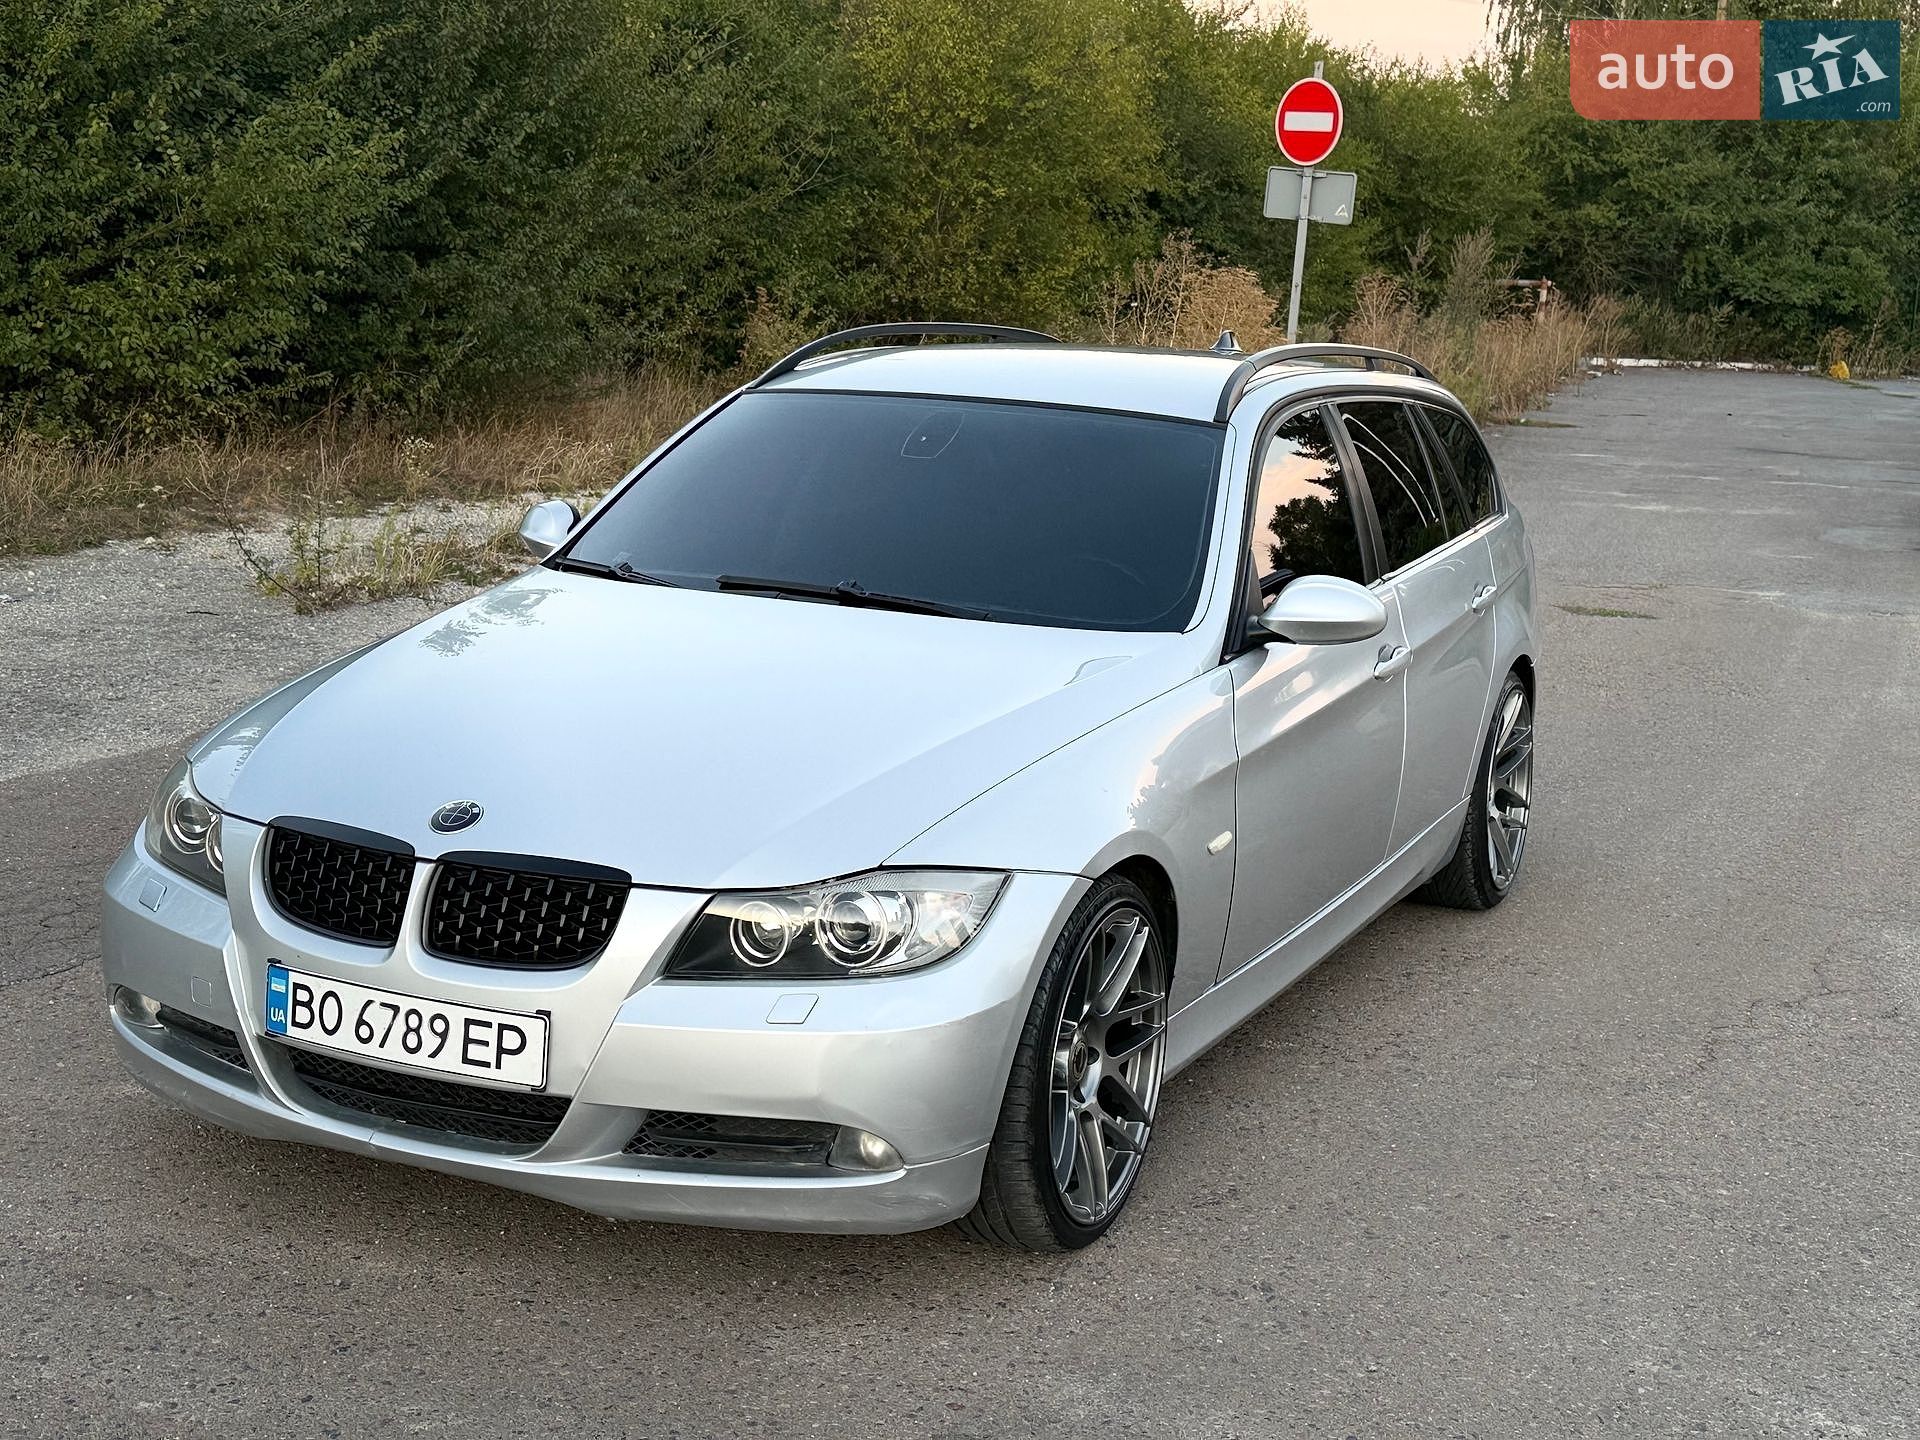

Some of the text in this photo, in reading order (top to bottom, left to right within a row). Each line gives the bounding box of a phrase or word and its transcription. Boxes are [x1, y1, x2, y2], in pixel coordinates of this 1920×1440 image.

[270, 1008, 286, 1024] UA
[291, 982, 527, 1070] BO 6789 EP
